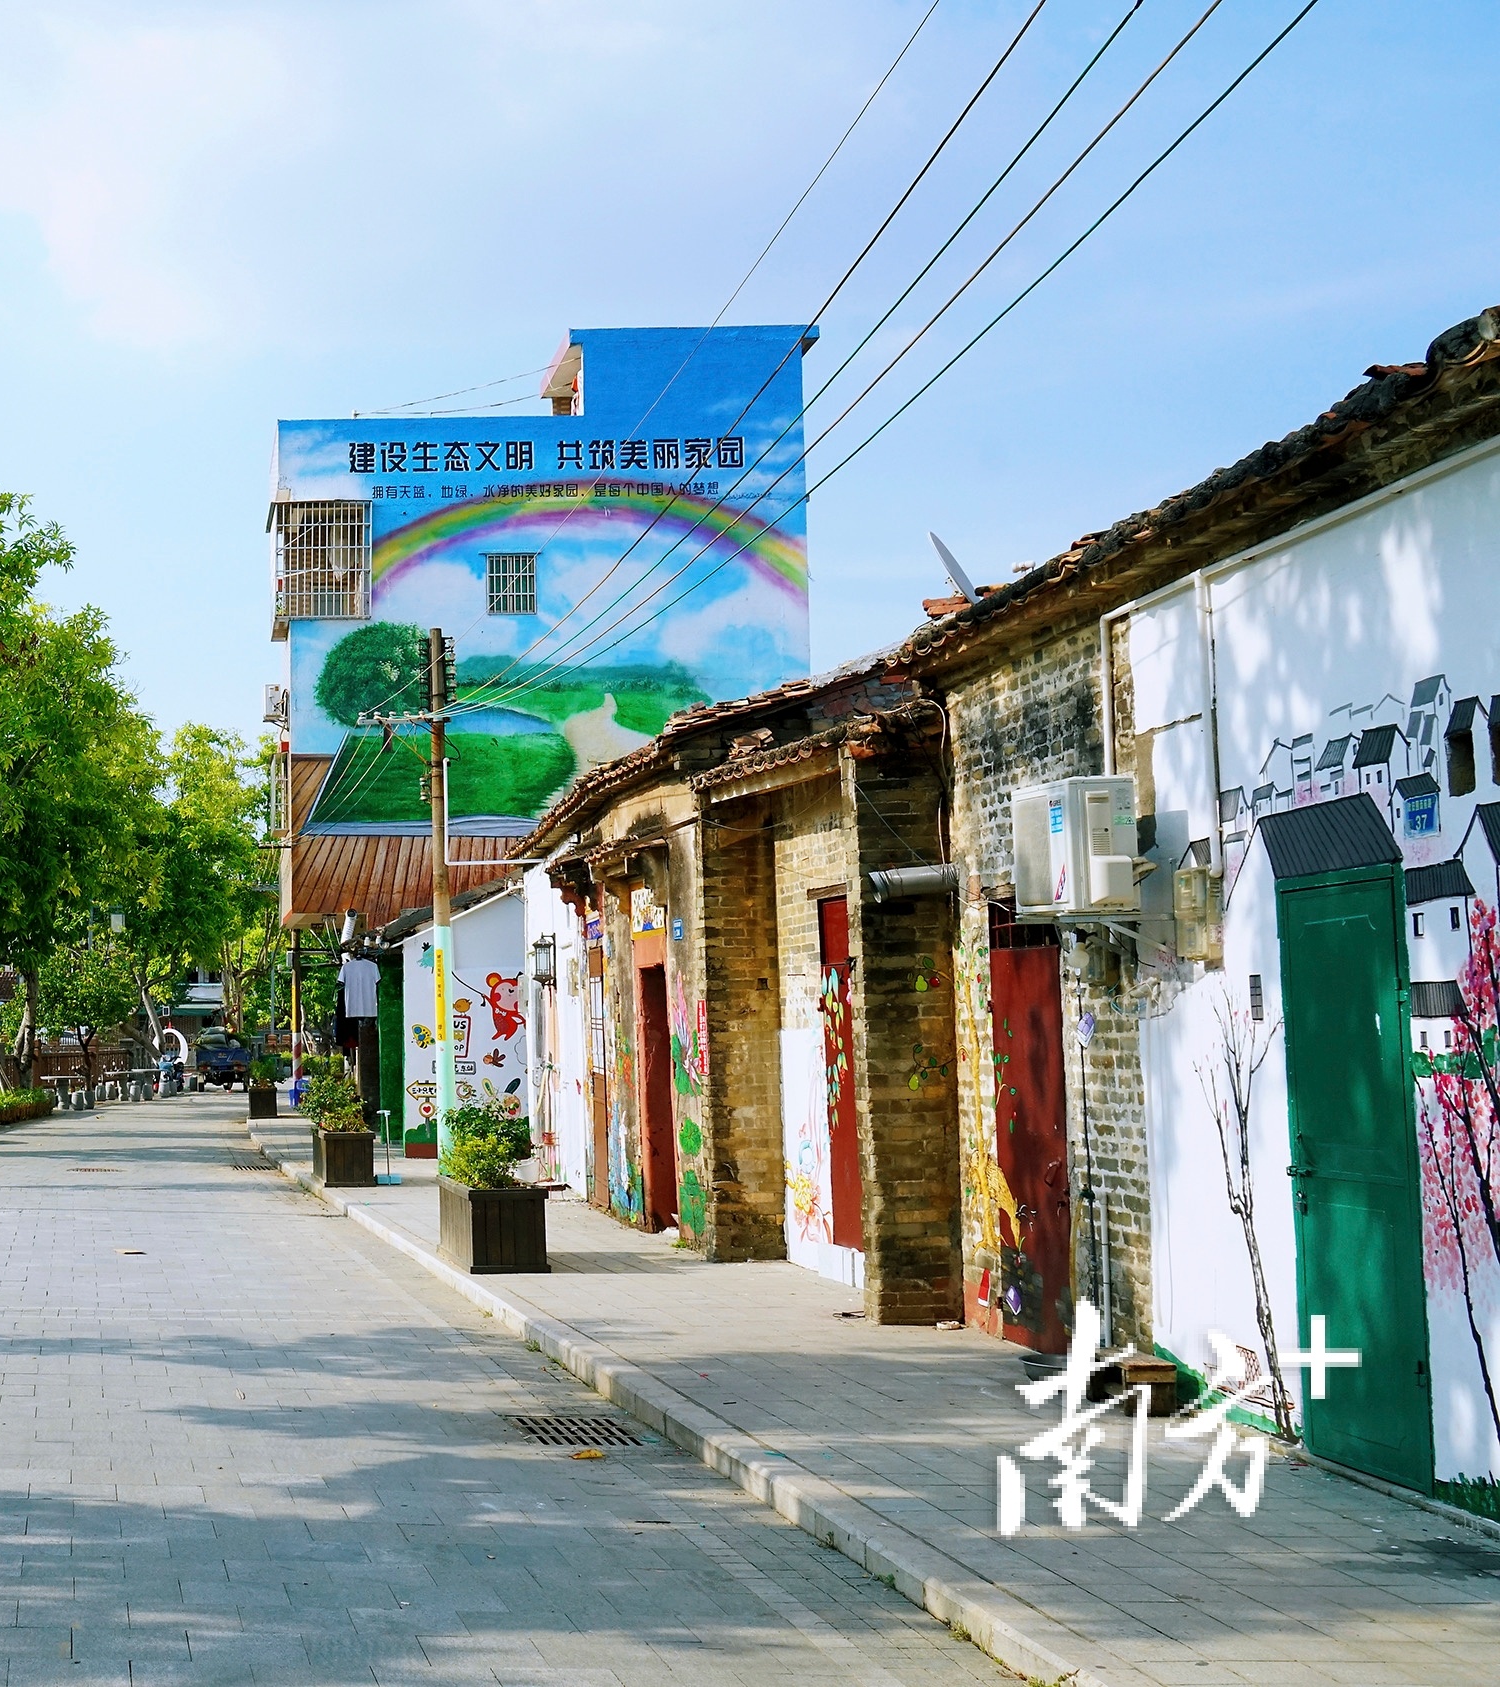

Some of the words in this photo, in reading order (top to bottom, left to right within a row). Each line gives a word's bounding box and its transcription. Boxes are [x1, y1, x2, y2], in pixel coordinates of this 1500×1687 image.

[349, 441, 534, 473] 建设生态文明
[557, 436, 745, 470] 共筑美丽家园
[1415, 814, 1427, 830] 37
[453, 1020, 466, 1029] US
